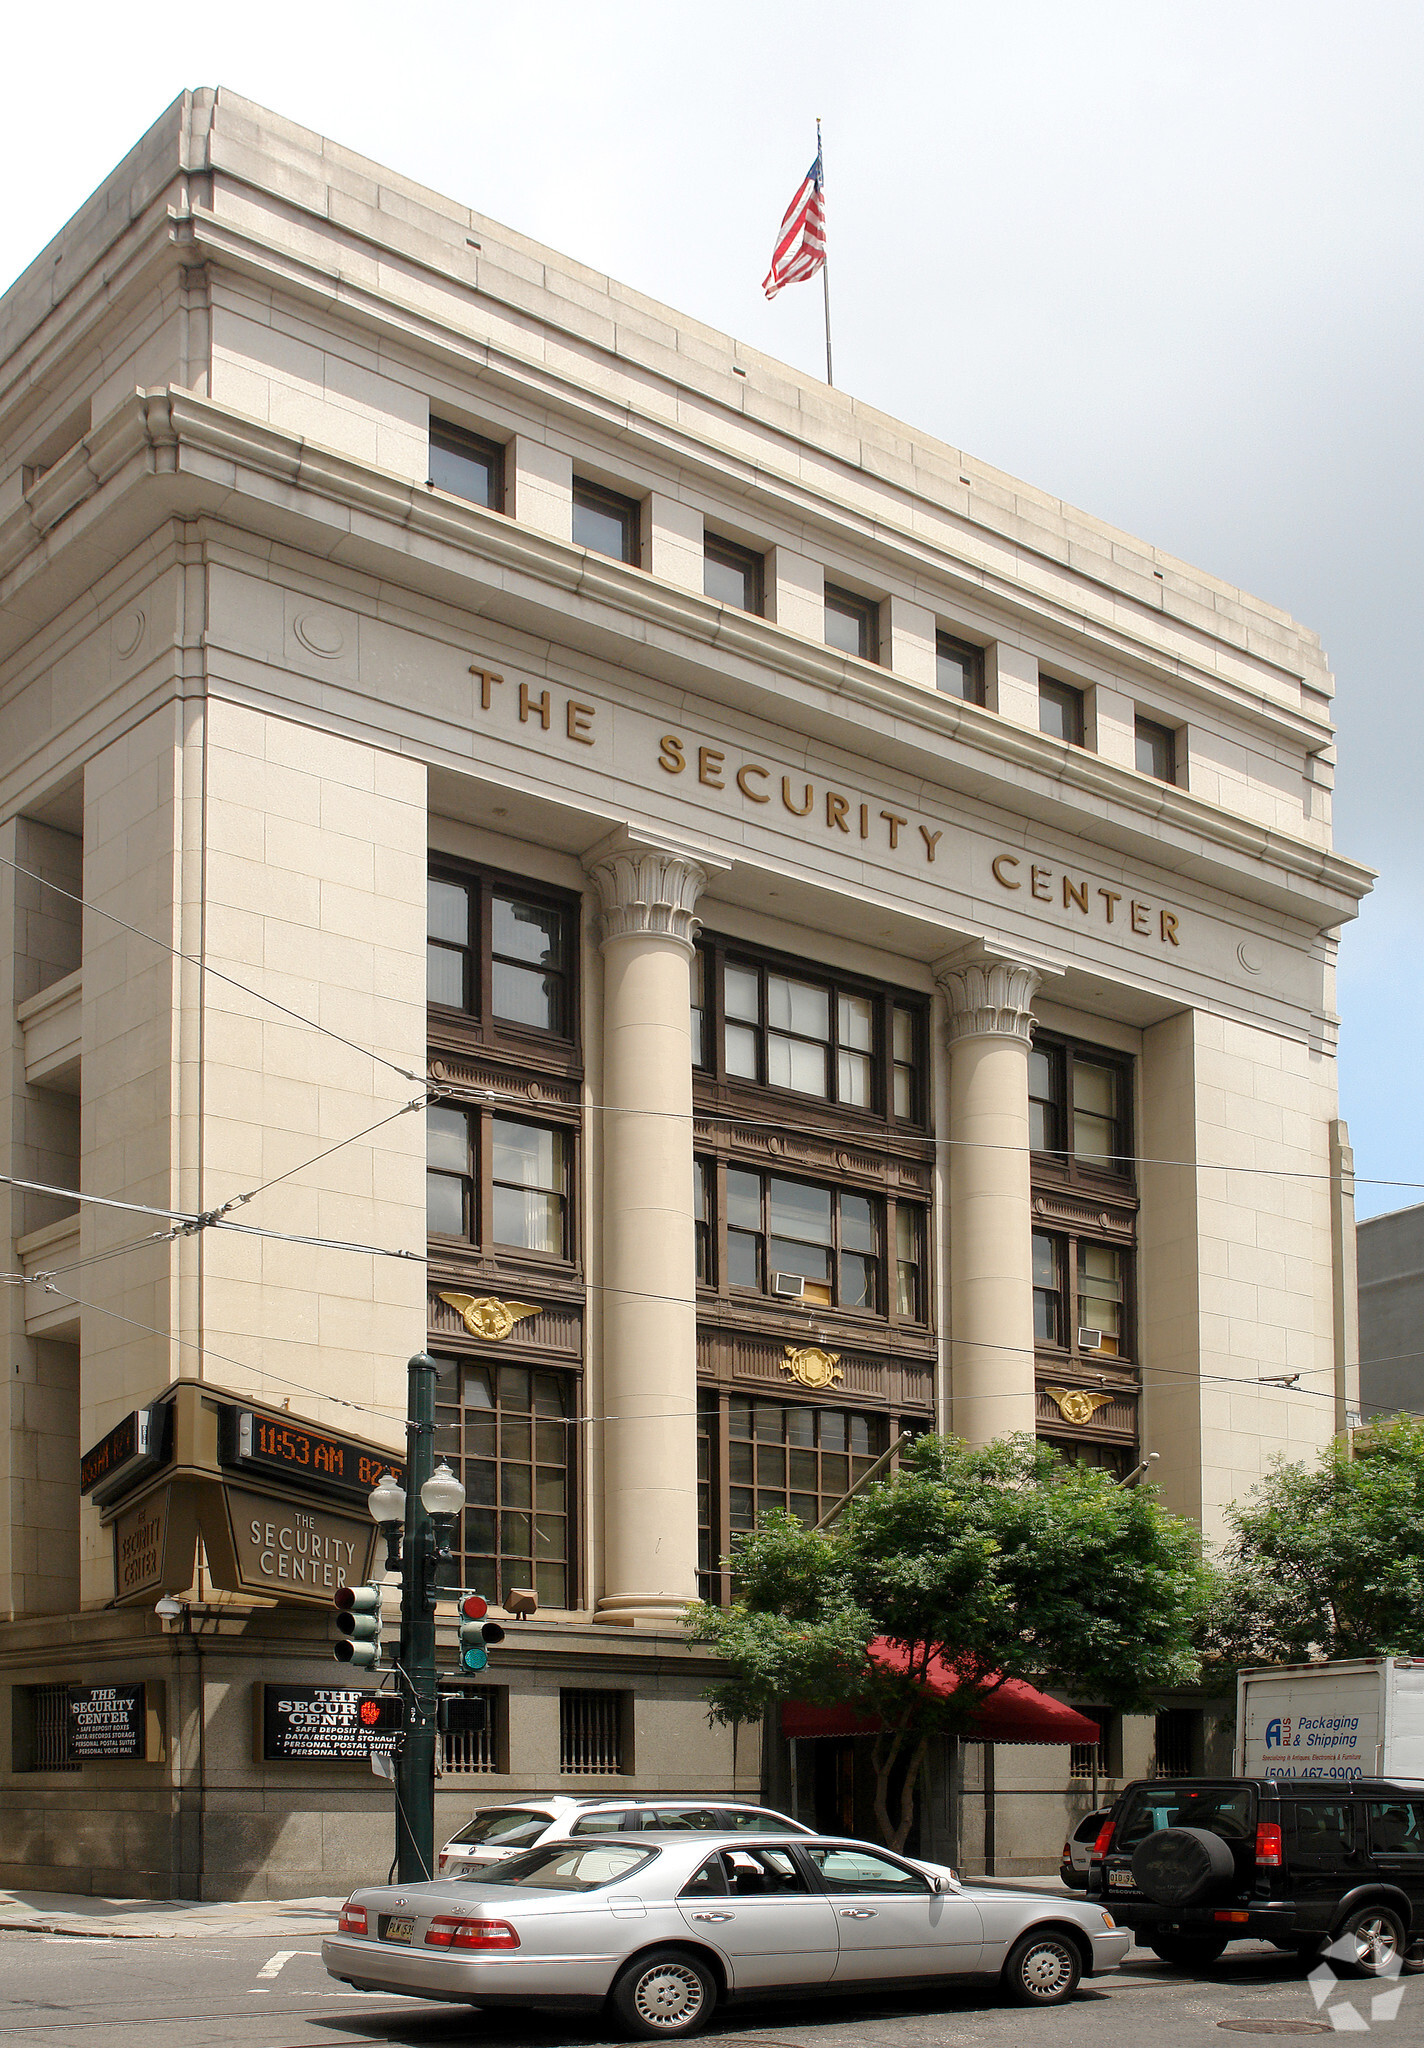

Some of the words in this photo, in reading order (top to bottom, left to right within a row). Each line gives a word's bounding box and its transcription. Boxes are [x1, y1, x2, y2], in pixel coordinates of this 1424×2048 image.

[469, 664, 595, 745] THE
[659, 735, 943, 861] SECURITY
[992, 854, 1181, 945] CENTER
[259, 1424, 310, 1465] 11:53
[314, 1443, 344, 1476] AM
[294, 1512, 315, 1530] THE
[122, 1517, 160, 1561] SECURITY
[250, 1520, 355, 1564] SECURITY
[124, 1549, 157, 1586] CENTER
[259, 1551, 346, 1588] CENTER
[90, 1688, 117, 1701] THE
[72, 1699, 135, 1714] SECURITY
[278, 1701, 358, 1715] SECUR
[77, 1711, 129, 1725] CENTER
[288, 1713, 357, 1726] CENT
[1298, 1715, 1359, 1731] Packaging
[285, 1733, 355, 1742] DATA/RECORDS
[1282, 1717, 1291, 1746] PLUS
[1293, 1734, 1300, 1746] &
[1306, 1733, 1357, 1748] Shipping
[1262, 1754, 1286, 1762] Specializing
